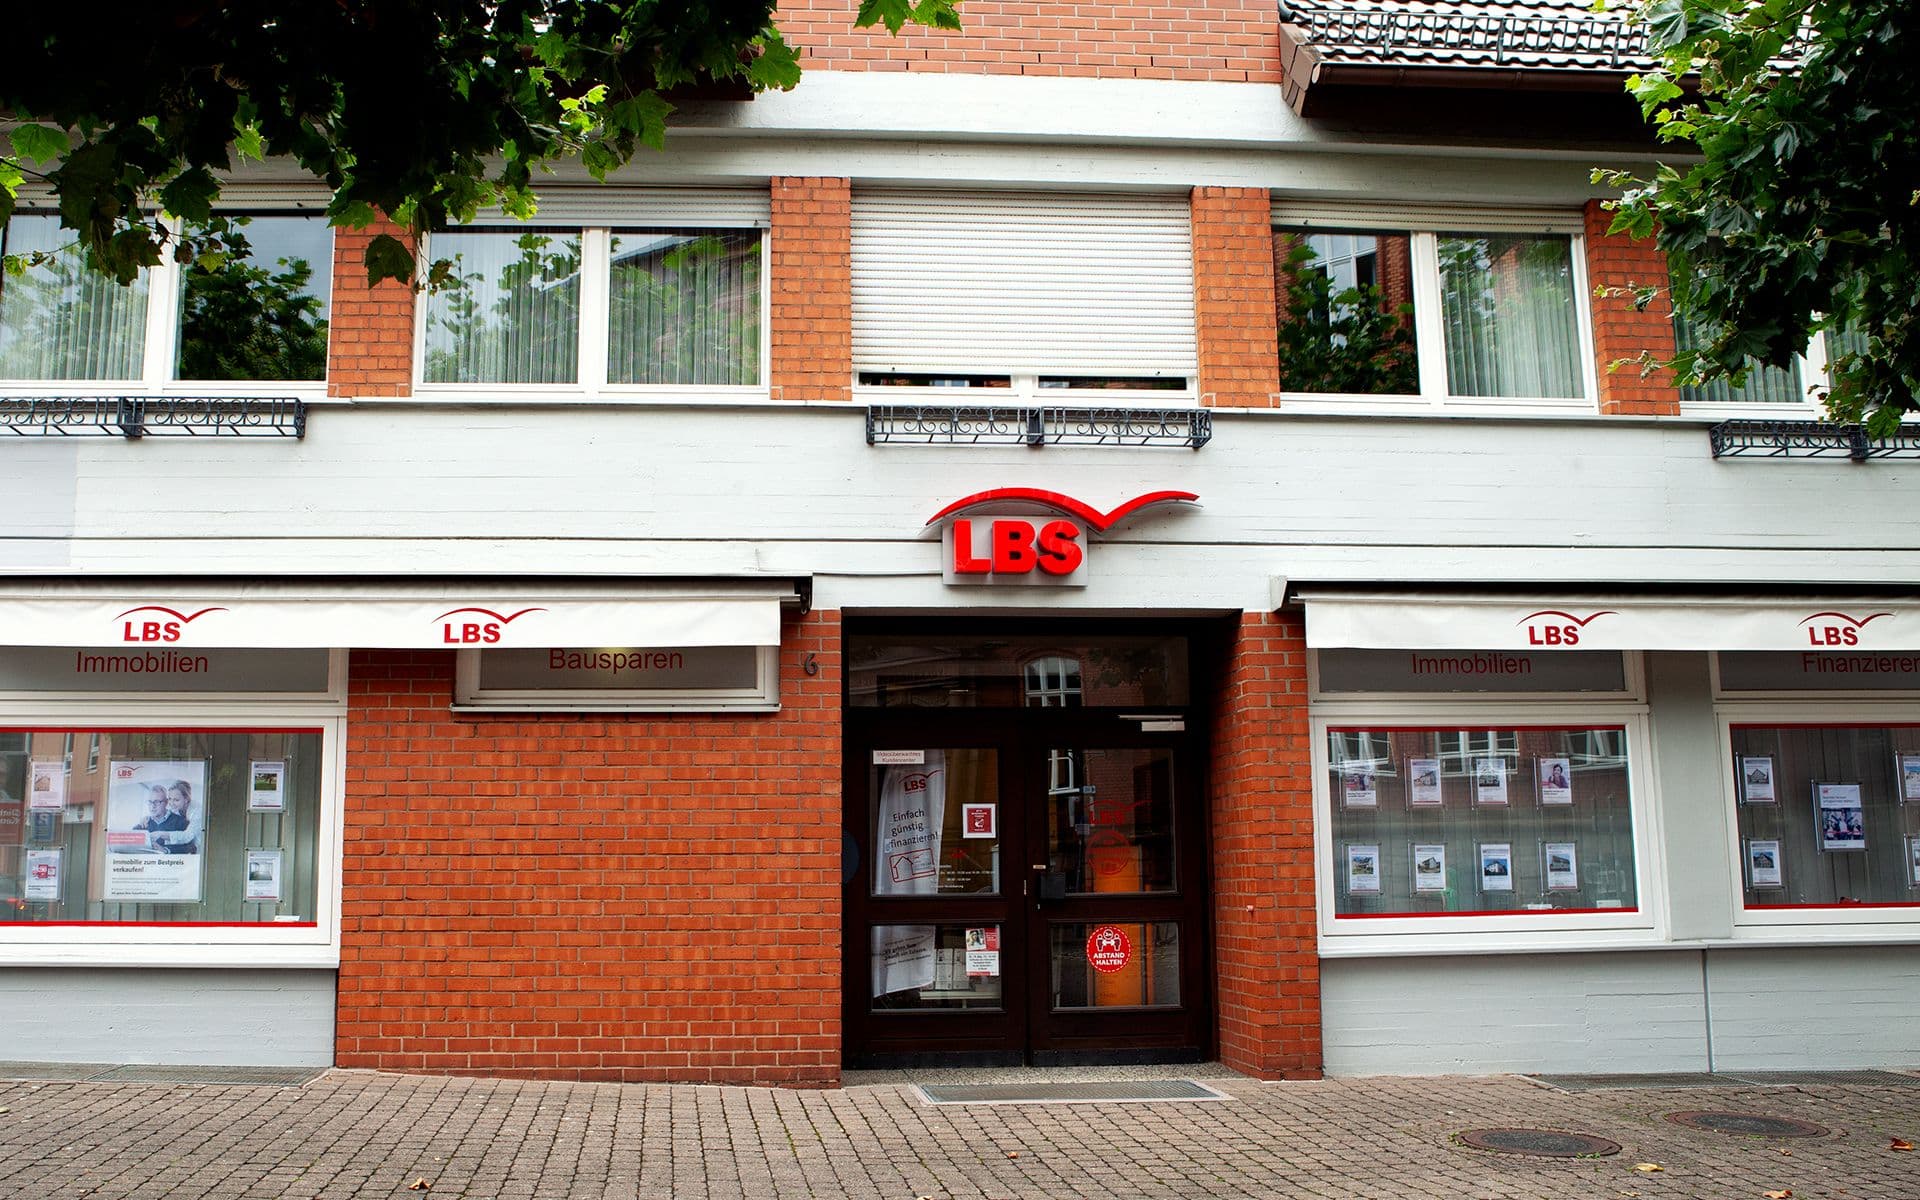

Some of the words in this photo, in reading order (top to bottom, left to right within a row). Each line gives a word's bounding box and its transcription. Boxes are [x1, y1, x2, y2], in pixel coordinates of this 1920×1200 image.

[953, 519, 1083, 576] LBS
[123, 621, 181, 642] LBS
[443, 623, 501, 644] LBS
[1528, 625, 1580, 645] LBS
[1808, 626, 1859, 646] LBS
[76, 651, 209, 673] Immobilien
[549, 648, 683, 675] Bausparen
[803, 653, 818, 676] 6
[1411, 653, 1531, 674] Immobilien
[904, 779, 927, 792] LBS
[892, 808, 925, 822] Einfach
[891, 822, 924, 837] günstig
